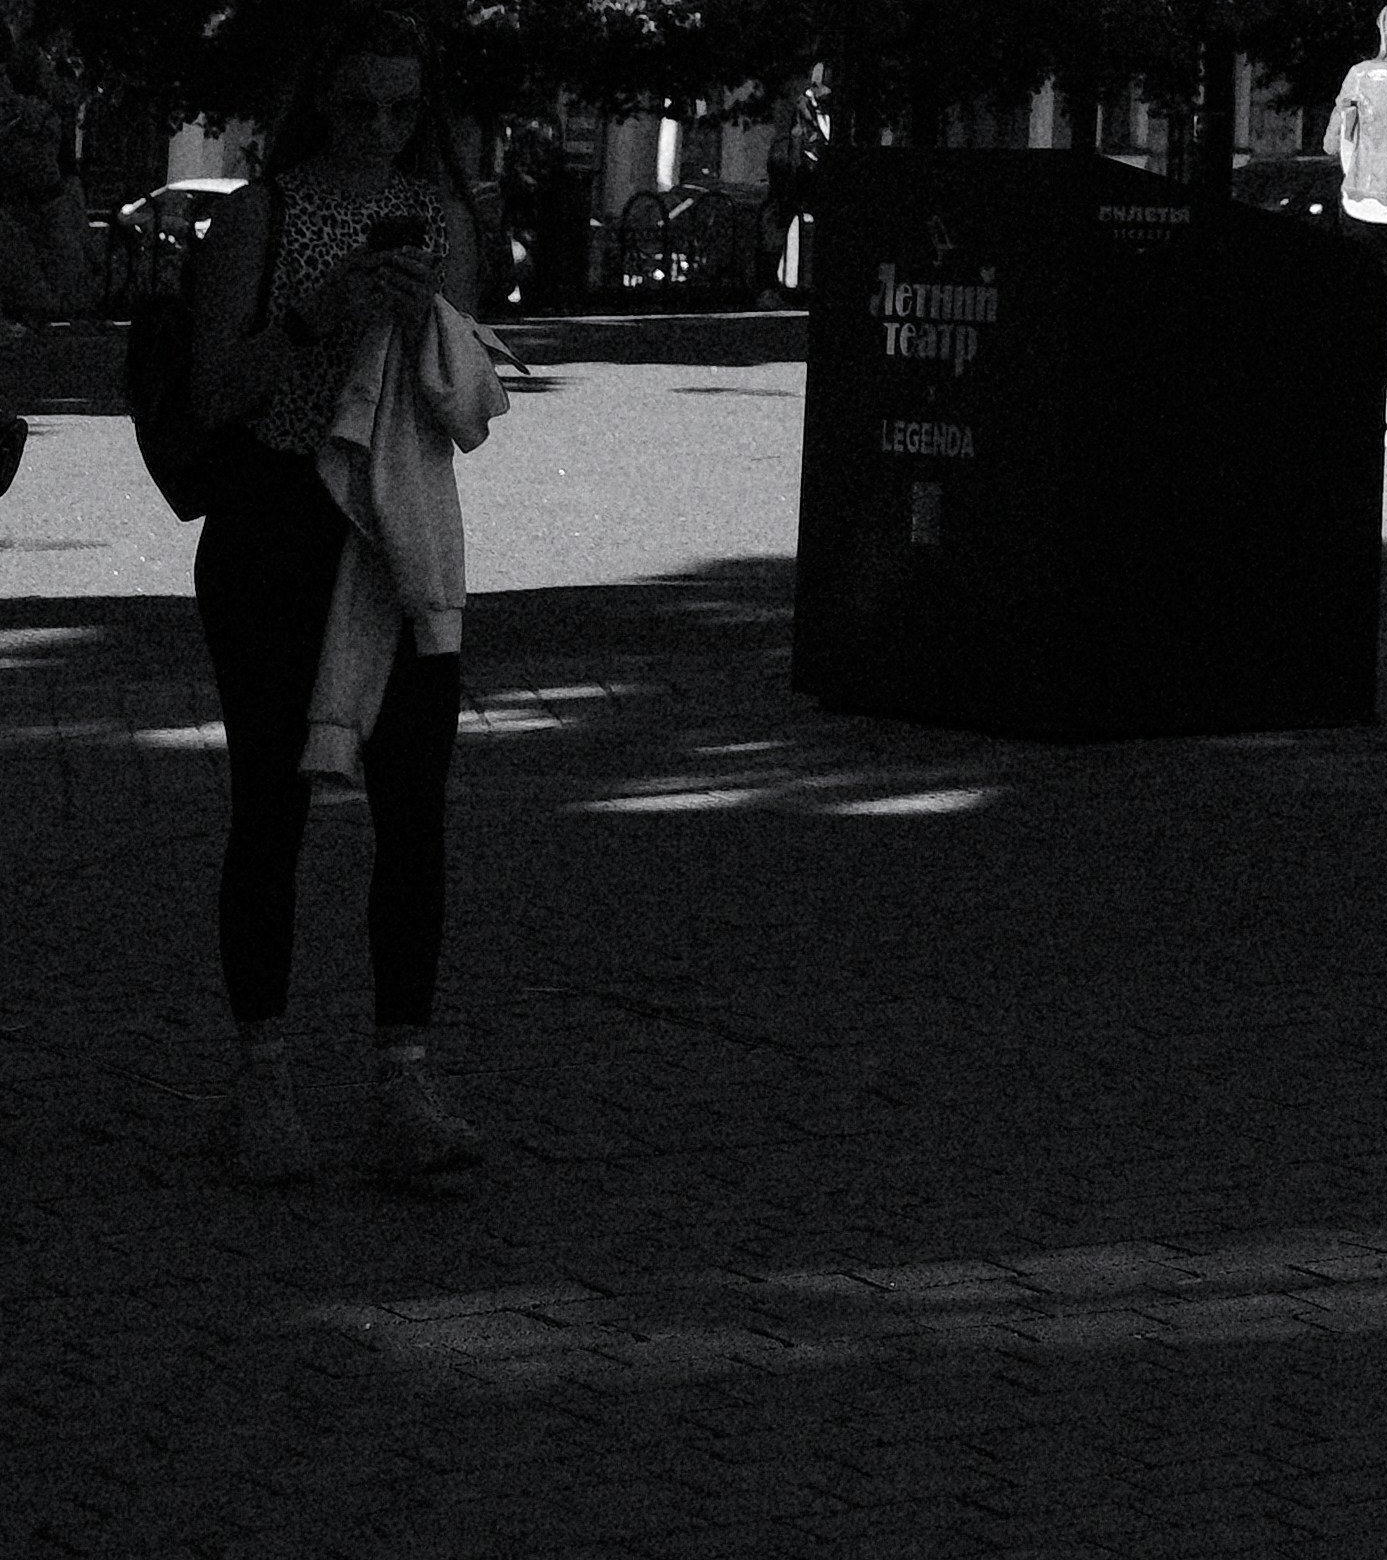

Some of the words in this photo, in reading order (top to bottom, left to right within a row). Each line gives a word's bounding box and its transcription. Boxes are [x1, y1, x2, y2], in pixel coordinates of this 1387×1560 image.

[869, 262, 999, 323] Летний
[884, 322, 979, 377] театр
[881, 419, 977, 459] LEGENDA
